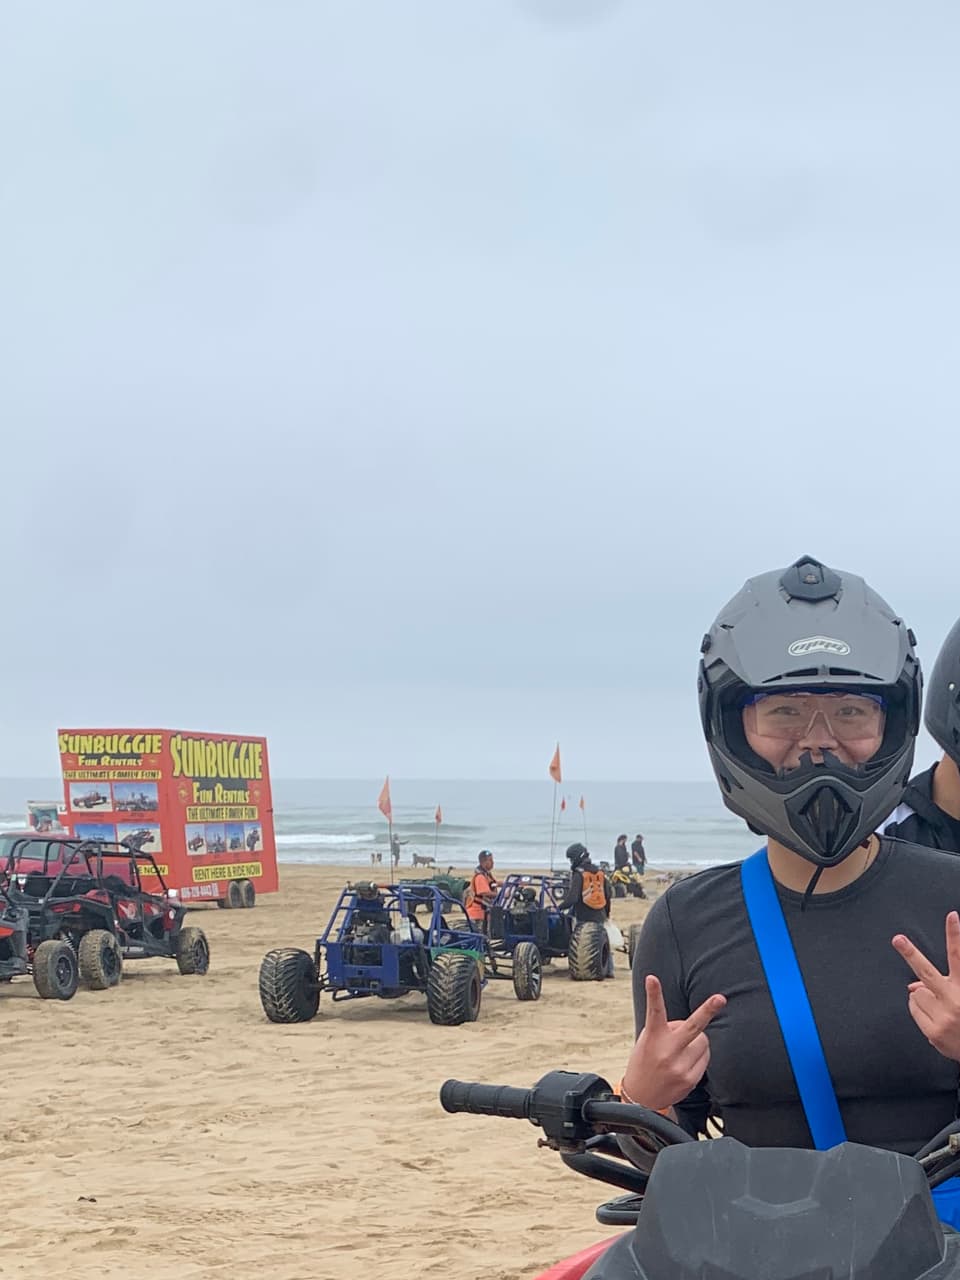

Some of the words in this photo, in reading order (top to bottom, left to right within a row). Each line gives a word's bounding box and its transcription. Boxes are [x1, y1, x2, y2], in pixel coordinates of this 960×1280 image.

[59, 733, 162, 754] SUNBUGGIE
[170, 734, 262, 779] SUNBUGGIE
[195, 868, 211, 880] RENT
[211, 867, 226, 879] HERE
[232, 865, 245, 876] RIDE
[245, 863, 260, 876] NOW
